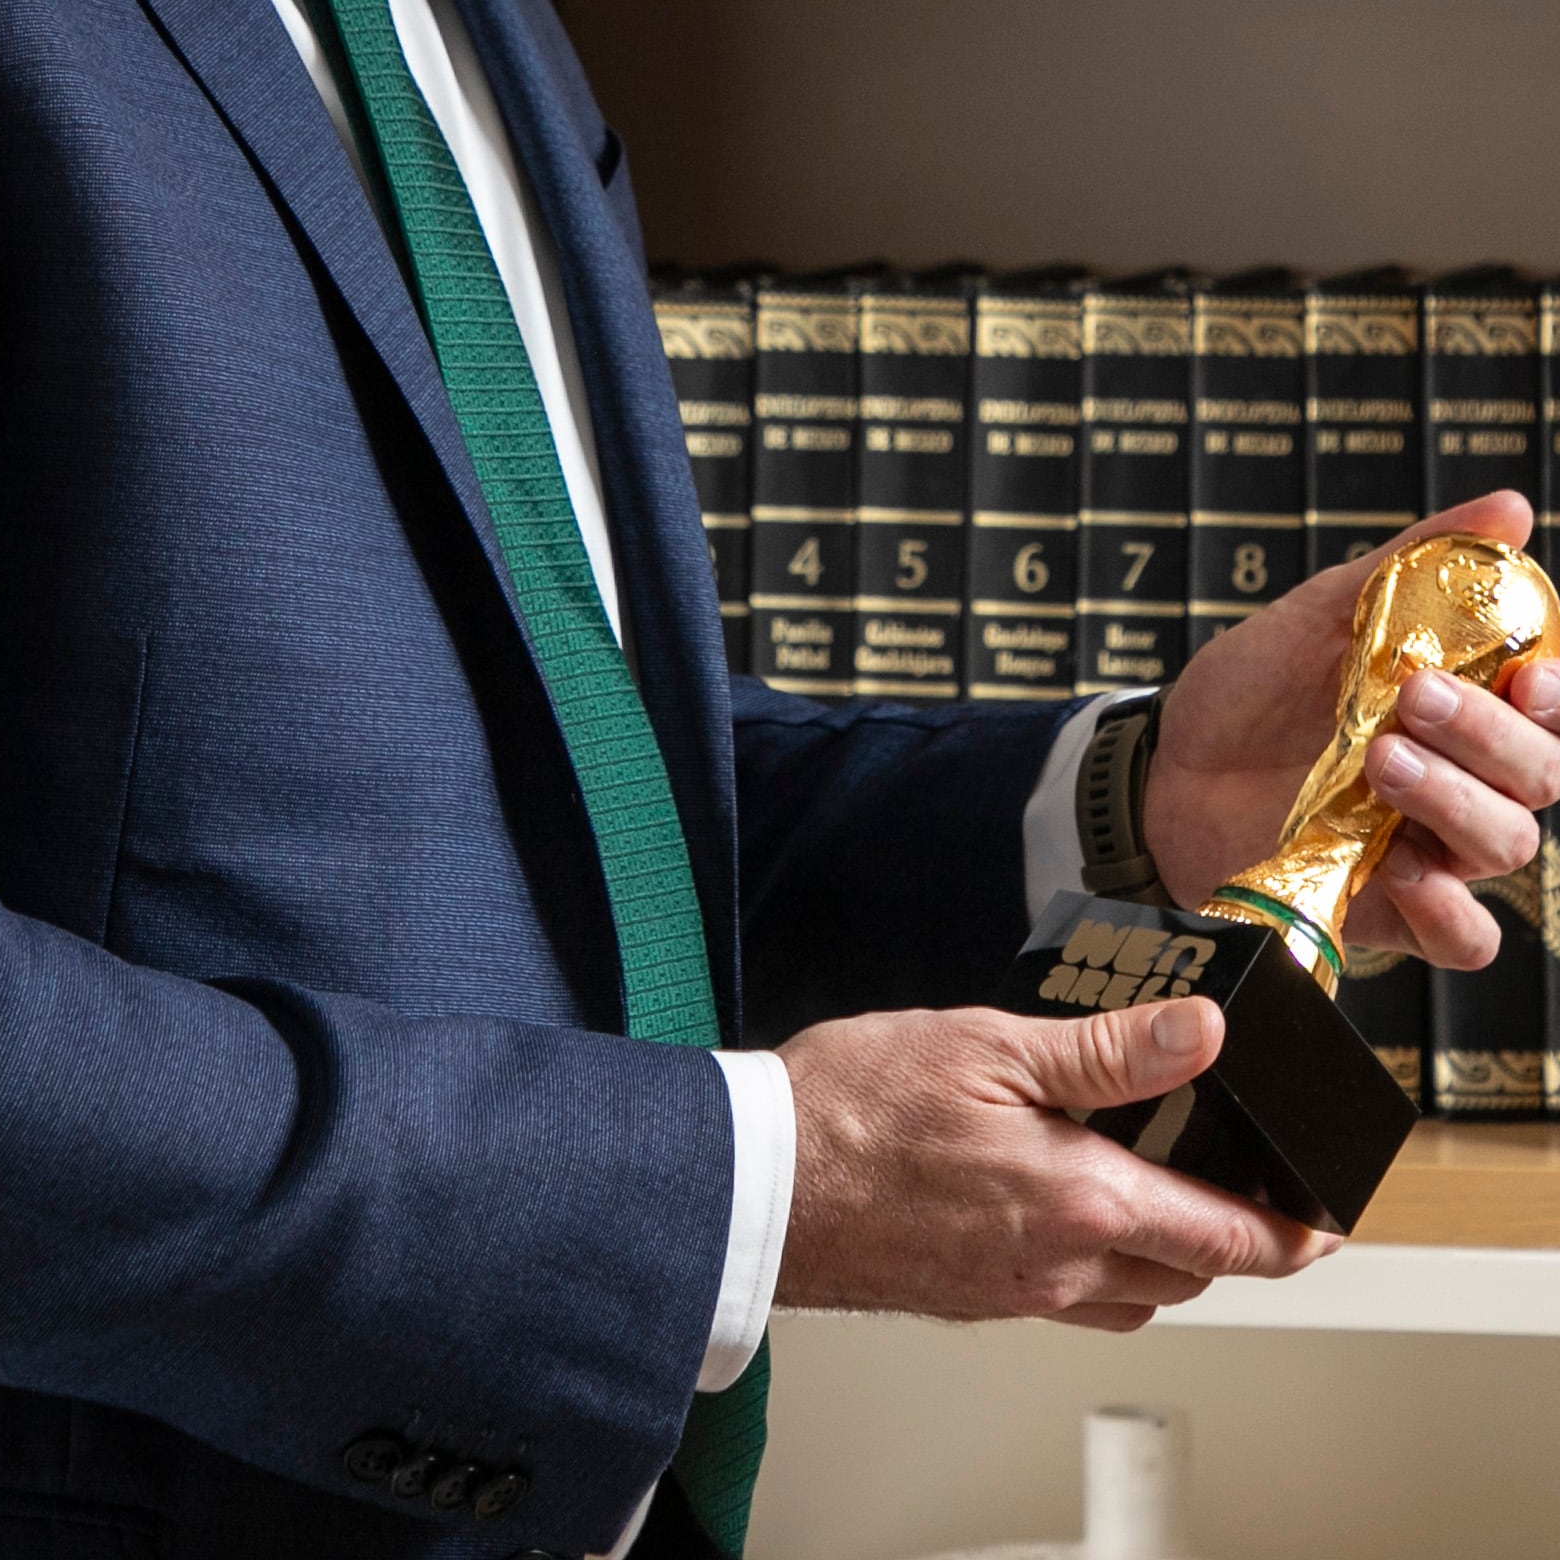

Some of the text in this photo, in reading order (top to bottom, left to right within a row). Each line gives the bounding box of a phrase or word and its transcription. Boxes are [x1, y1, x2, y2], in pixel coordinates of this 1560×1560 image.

[787, 537, 824, 586] 4
[895, 540, 928, 589] 5
[1013, 542, 1049, 593] 6
[1121, 542, 1155, 591] 7
[1231, 543, 1268, 593] 8
[1062, 919, 1172, 978] WE
